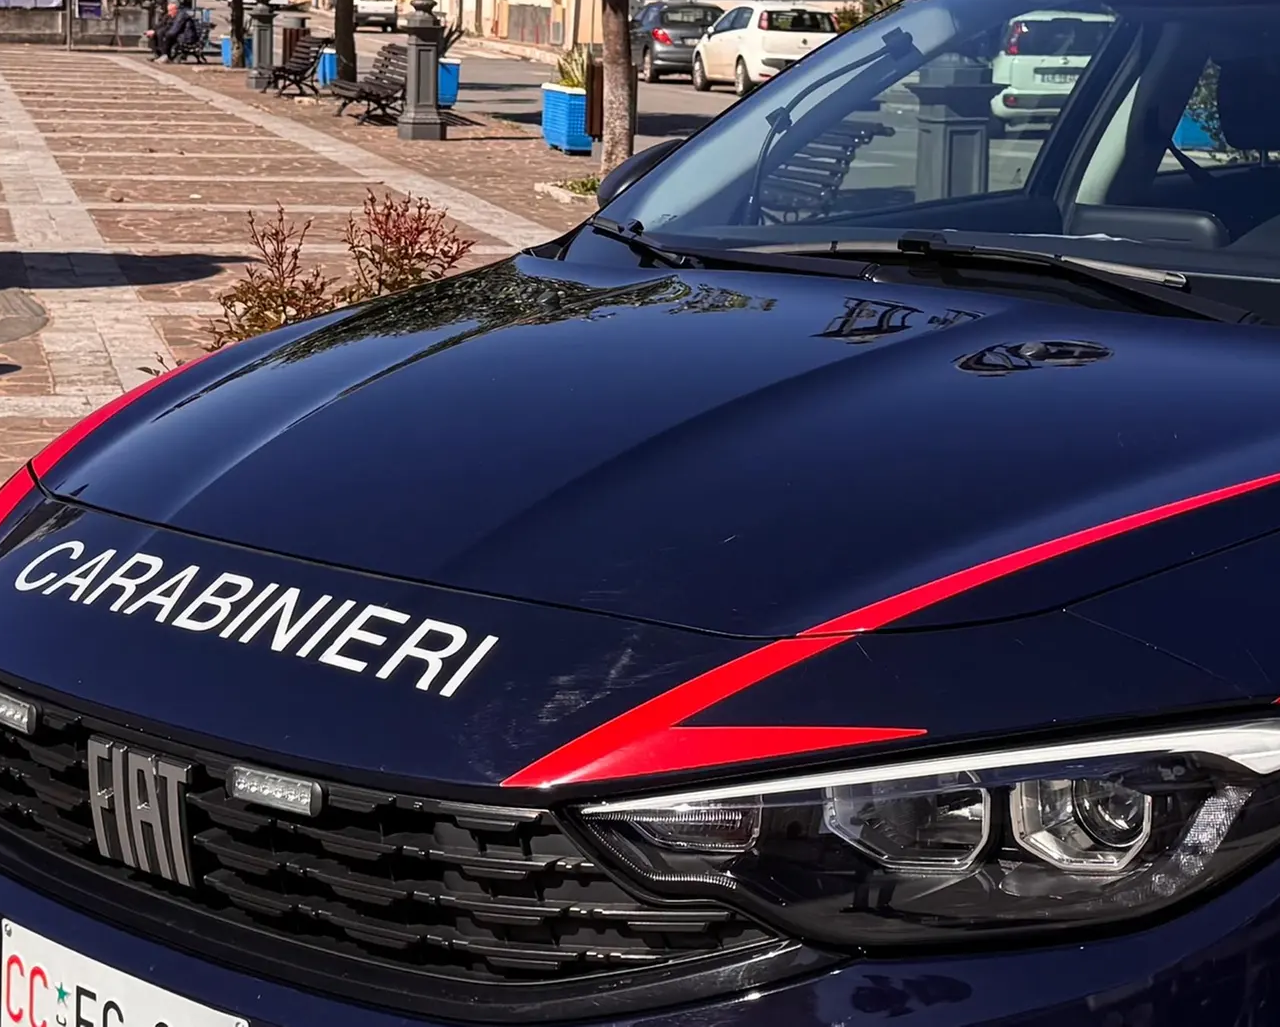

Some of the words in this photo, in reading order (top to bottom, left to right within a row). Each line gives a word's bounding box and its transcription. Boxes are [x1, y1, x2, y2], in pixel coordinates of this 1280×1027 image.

[14, 540, 499, 699] CARABINIERI
[87, 734, 193, 888] FIAT
[6, 954, 49, 1027] CC
